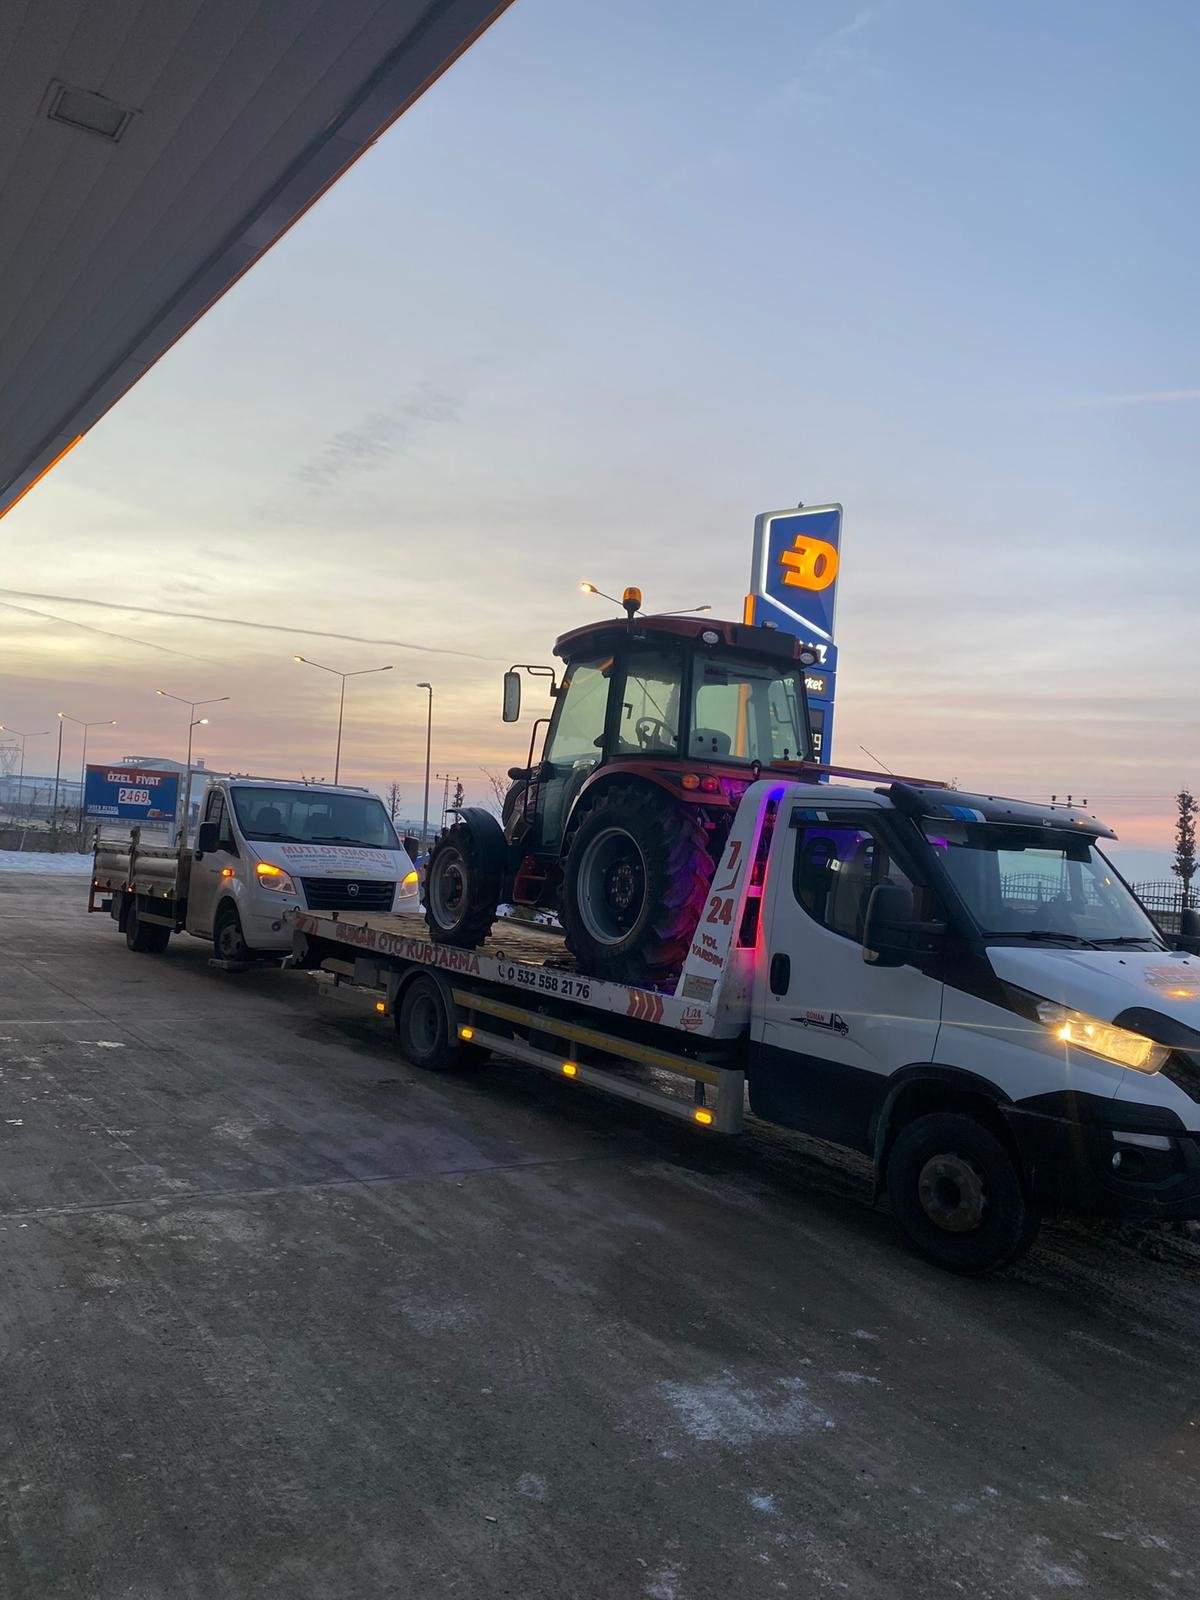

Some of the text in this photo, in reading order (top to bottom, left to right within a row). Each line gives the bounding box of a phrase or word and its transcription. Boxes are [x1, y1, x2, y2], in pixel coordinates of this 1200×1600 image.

[107, 771, 161, 786] ÖZEL FİYAT
[120, 789, 148, 802] 2469
[706, 896, 735, 926] 24
[702, 932, 718, 950] YOL
[378, 933, 404, 956] OTO
[406, 942, 481, 975] KURTARMA
[692, 943, 724, 968] YARDIM
[507, 967, 590, 999] 0 532 558 21 76
